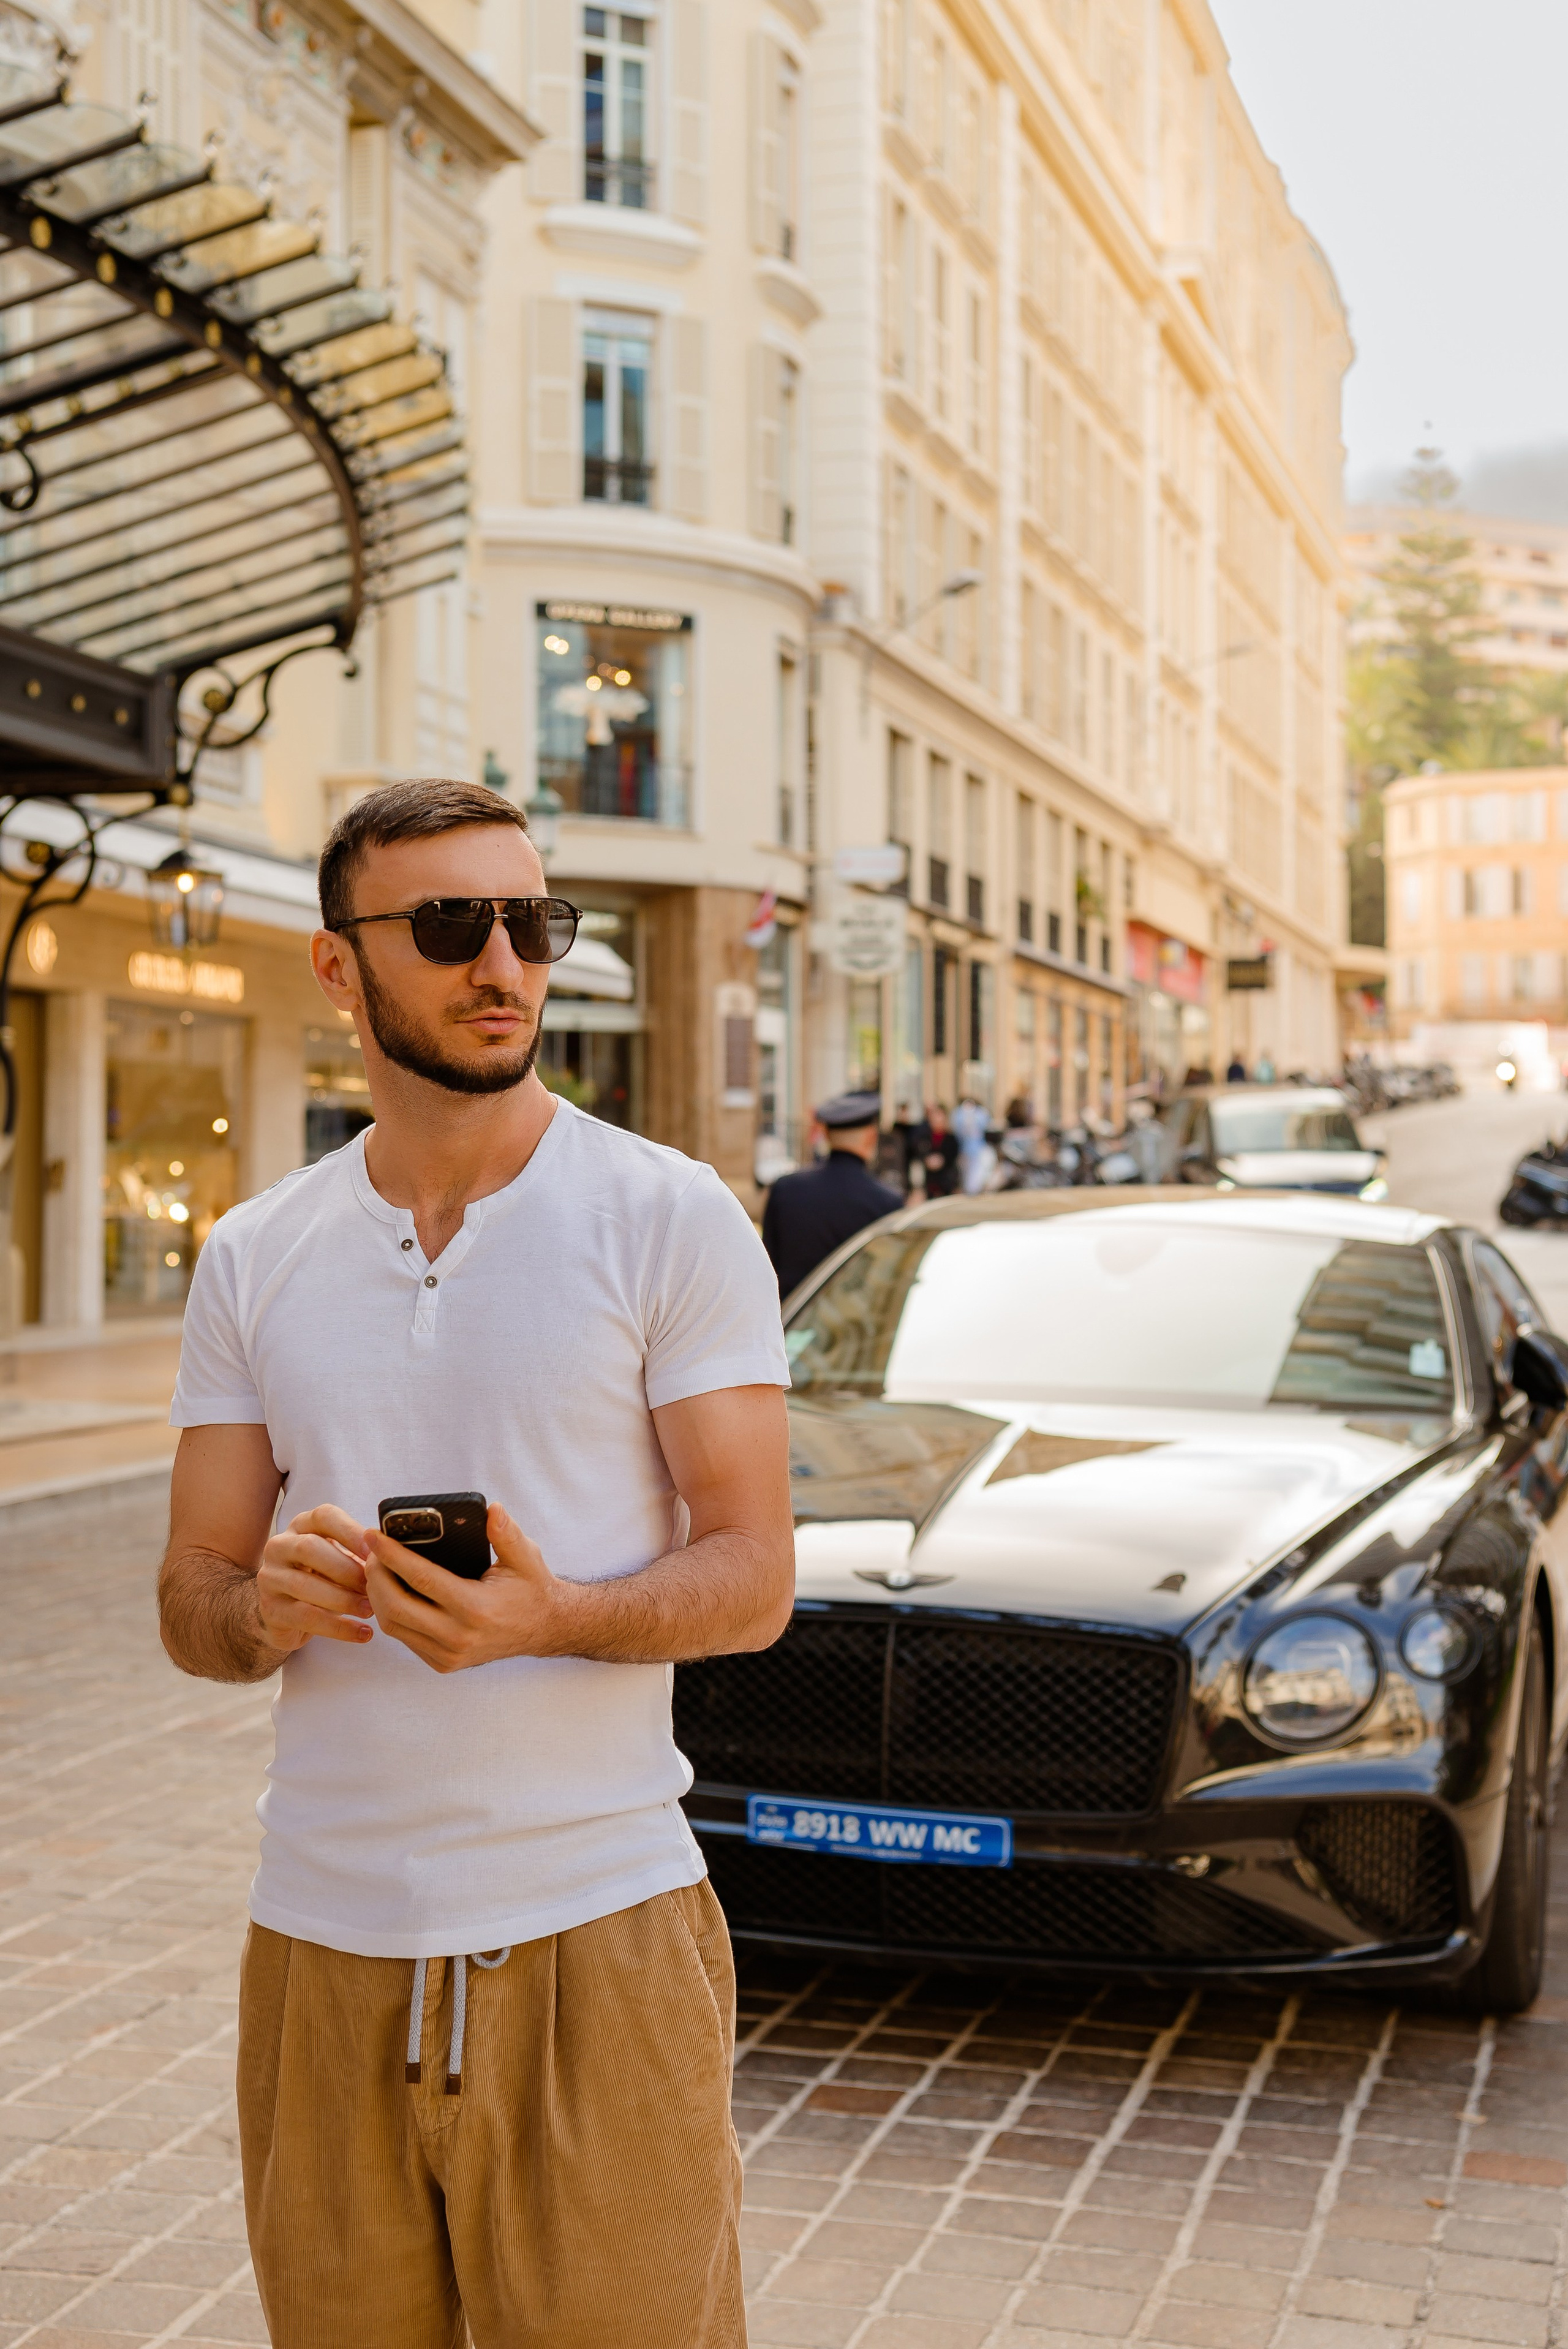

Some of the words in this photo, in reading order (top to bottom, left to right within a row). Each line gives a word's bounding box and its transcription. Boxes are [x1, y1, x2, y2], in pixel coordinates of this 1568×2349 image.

[793, 1809, 861, 1844] 8918
[868, 1819, 929, 1849] WW
[933, 1825, 981, 1855] MC
